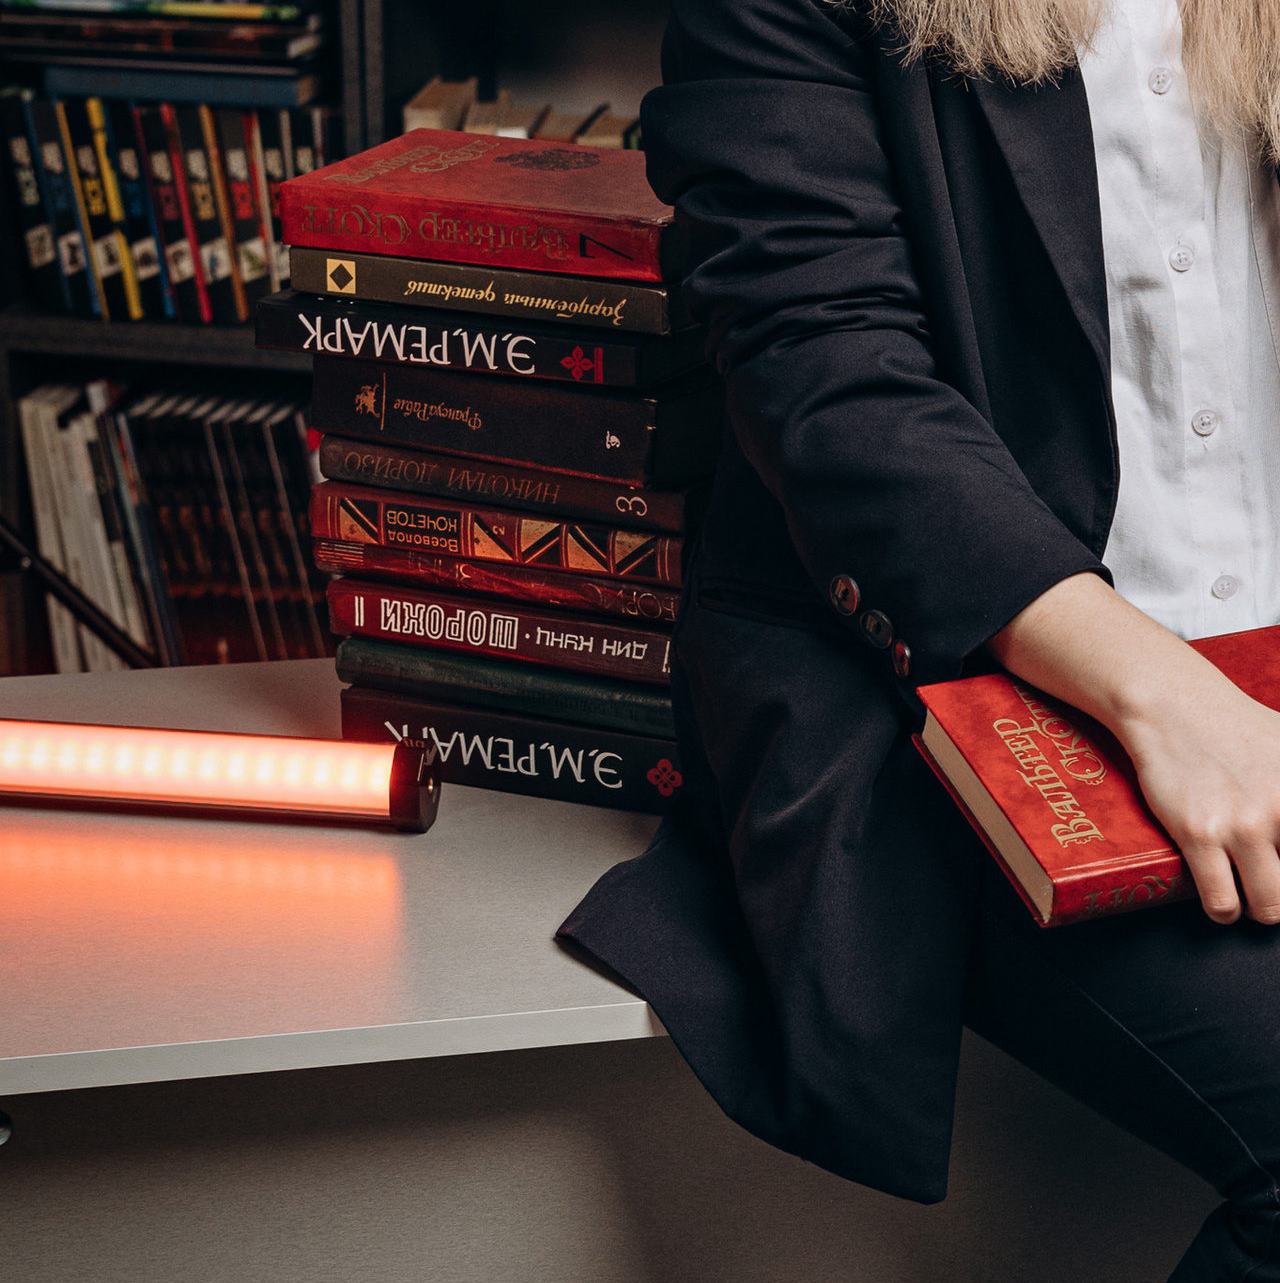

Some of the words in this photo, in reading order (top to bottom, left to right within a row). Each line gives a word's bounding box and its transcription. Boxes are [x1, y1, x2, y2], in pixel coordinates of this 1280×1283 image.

[402, 279, 496, 305] детектив
[503, 294, 627, 326] Зарубежный
[343, 450, 440, 485] ДОРИЗО
[447, 467, 561, 505] НИКОЛАЙ
[386, 510, 458, 533] КОЧЕТОВ
[387, 529, 459, 553] Всеволод
[380, 597, 519, 650] ШОРОХИ
[535, 626, 593, 653] КУНЦ
[602, 637, 648, 660] ДИН
